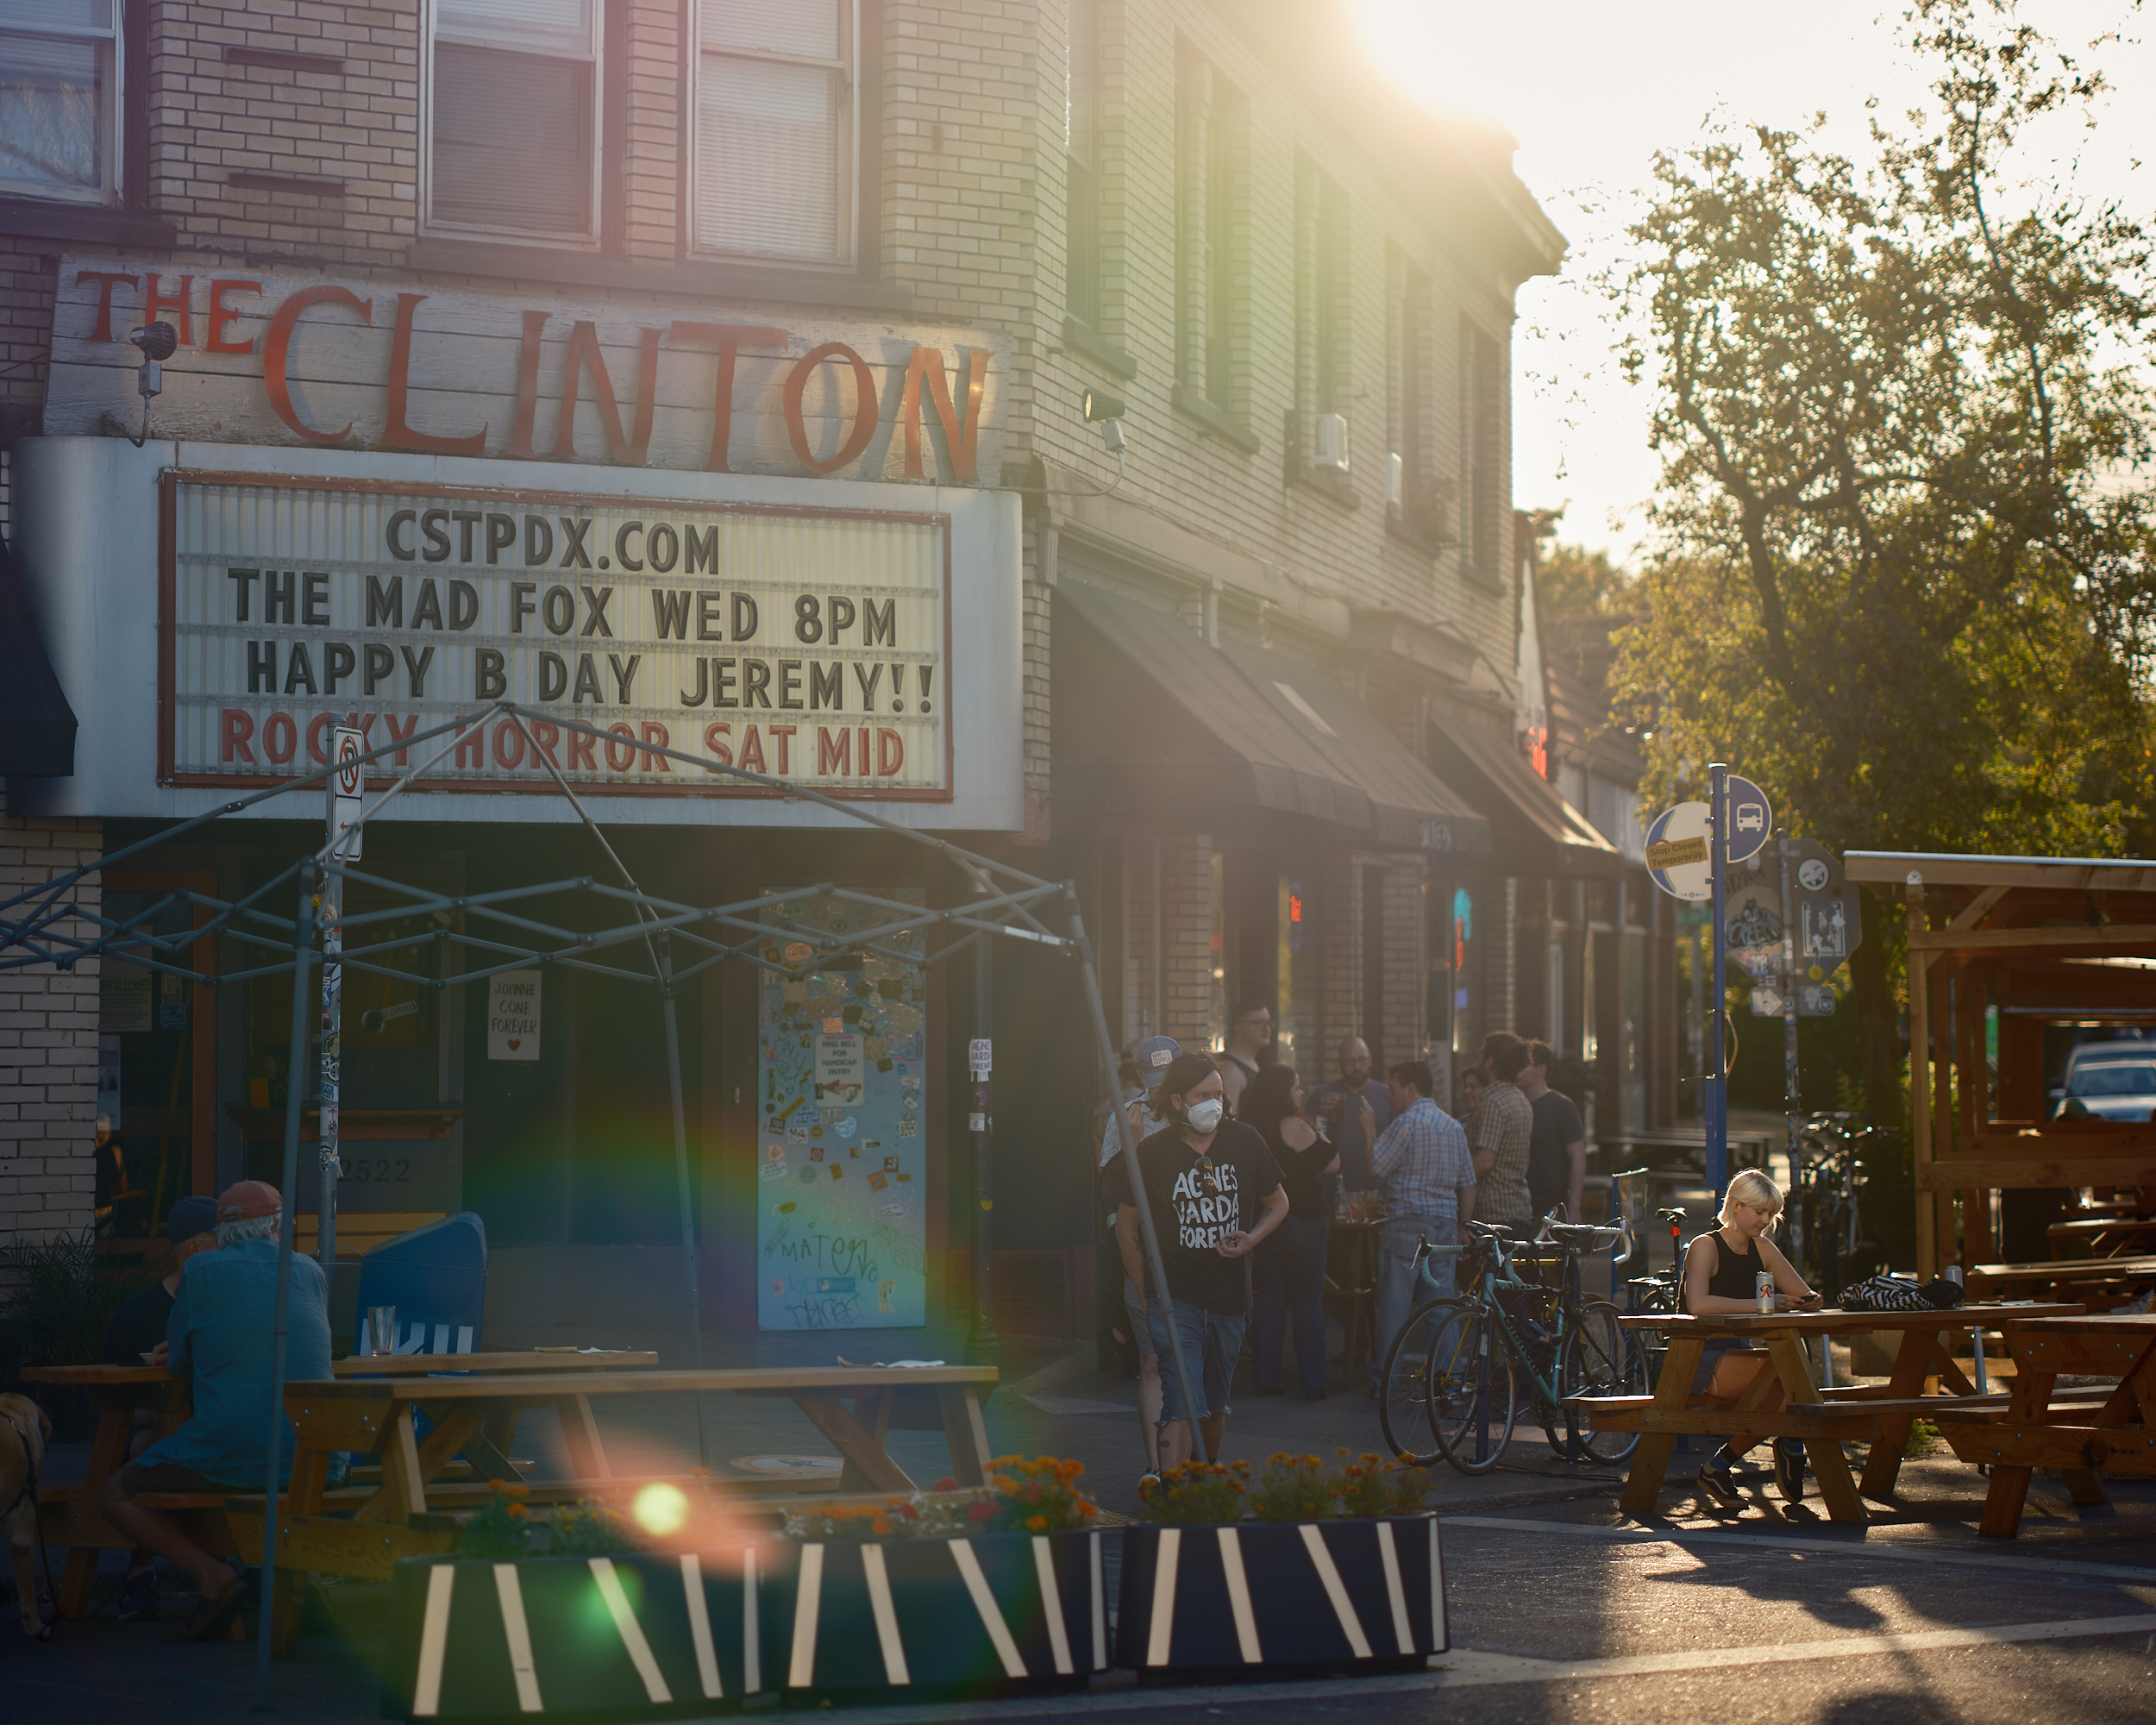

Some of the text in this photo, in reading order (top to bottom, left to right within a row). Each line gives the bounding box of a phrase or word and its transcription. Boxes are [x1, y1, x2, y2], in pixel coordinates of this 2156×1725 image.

[74, 269, 996, 483] THE CLINTON
[385, 507, 719, 575] CSTPDX.COM
[228, 567, 897, 649] THE MAD FOX WED 8PM
[247, 640, 933, 714] HAPPY B DAY JEREMY!!
[221, 707, 905, 777] ROCKY HORROR SAT MID
[1650, 839, 1702, 856] Stop Closed
[1651, 851, 1703, 867] Temporarily
[115, 979, 151, 992] ALLOWED
[494, 982, 536, 996] JOANNE
[491, 1017, 537, 1036] FOREVER
[341, 1160, 410, 1182] 2522
[1172, 1192, 1239, 1225] VARDA
